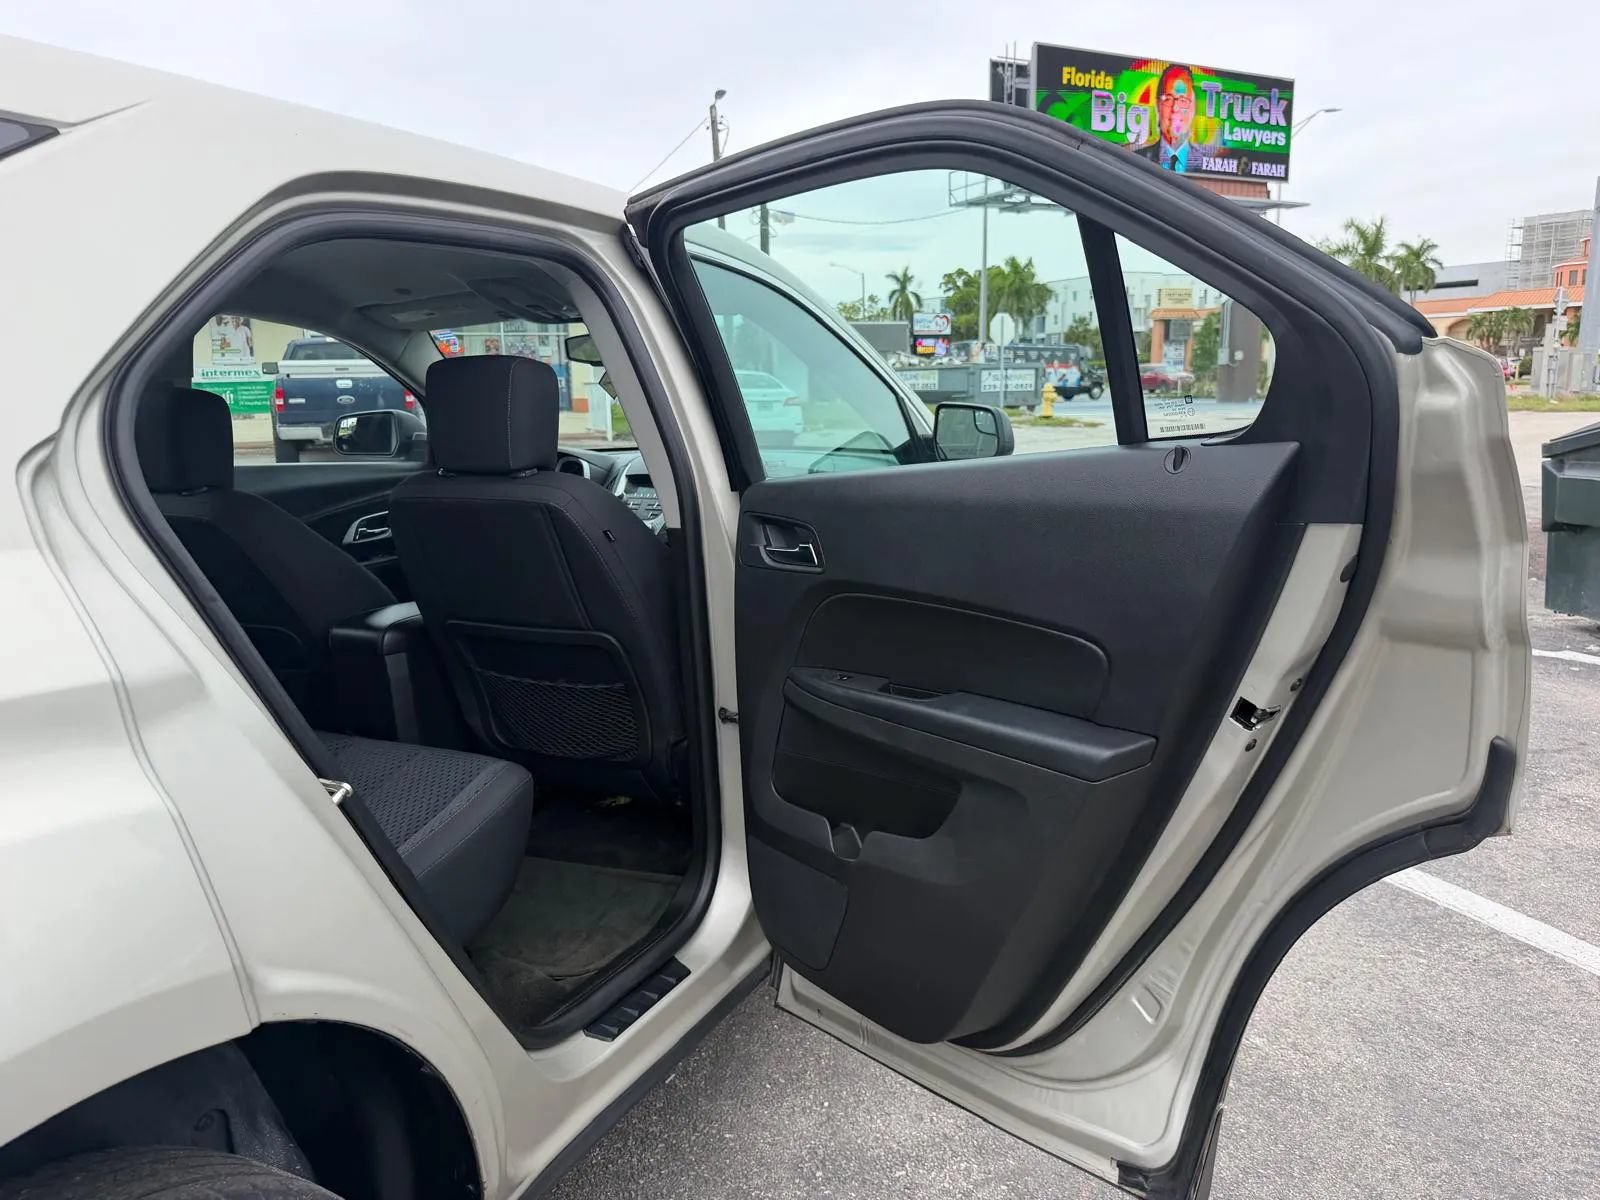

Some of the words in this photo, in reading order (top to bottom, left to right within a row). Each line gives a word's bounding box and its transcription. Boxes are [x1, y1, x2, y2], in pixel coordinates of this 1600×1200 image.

[1062, 66, 1113, 90] Florida
[1090, 90, 1150, 144] Big
[1200, 82, 1288, 127] Truck
[1223, 121, 1286, 147] Lawyers
[1201, 156, 1238, 173] FARAH
[1251, 161, 1286, 177] FARAH
[201, 368, 260, 378] intermex
